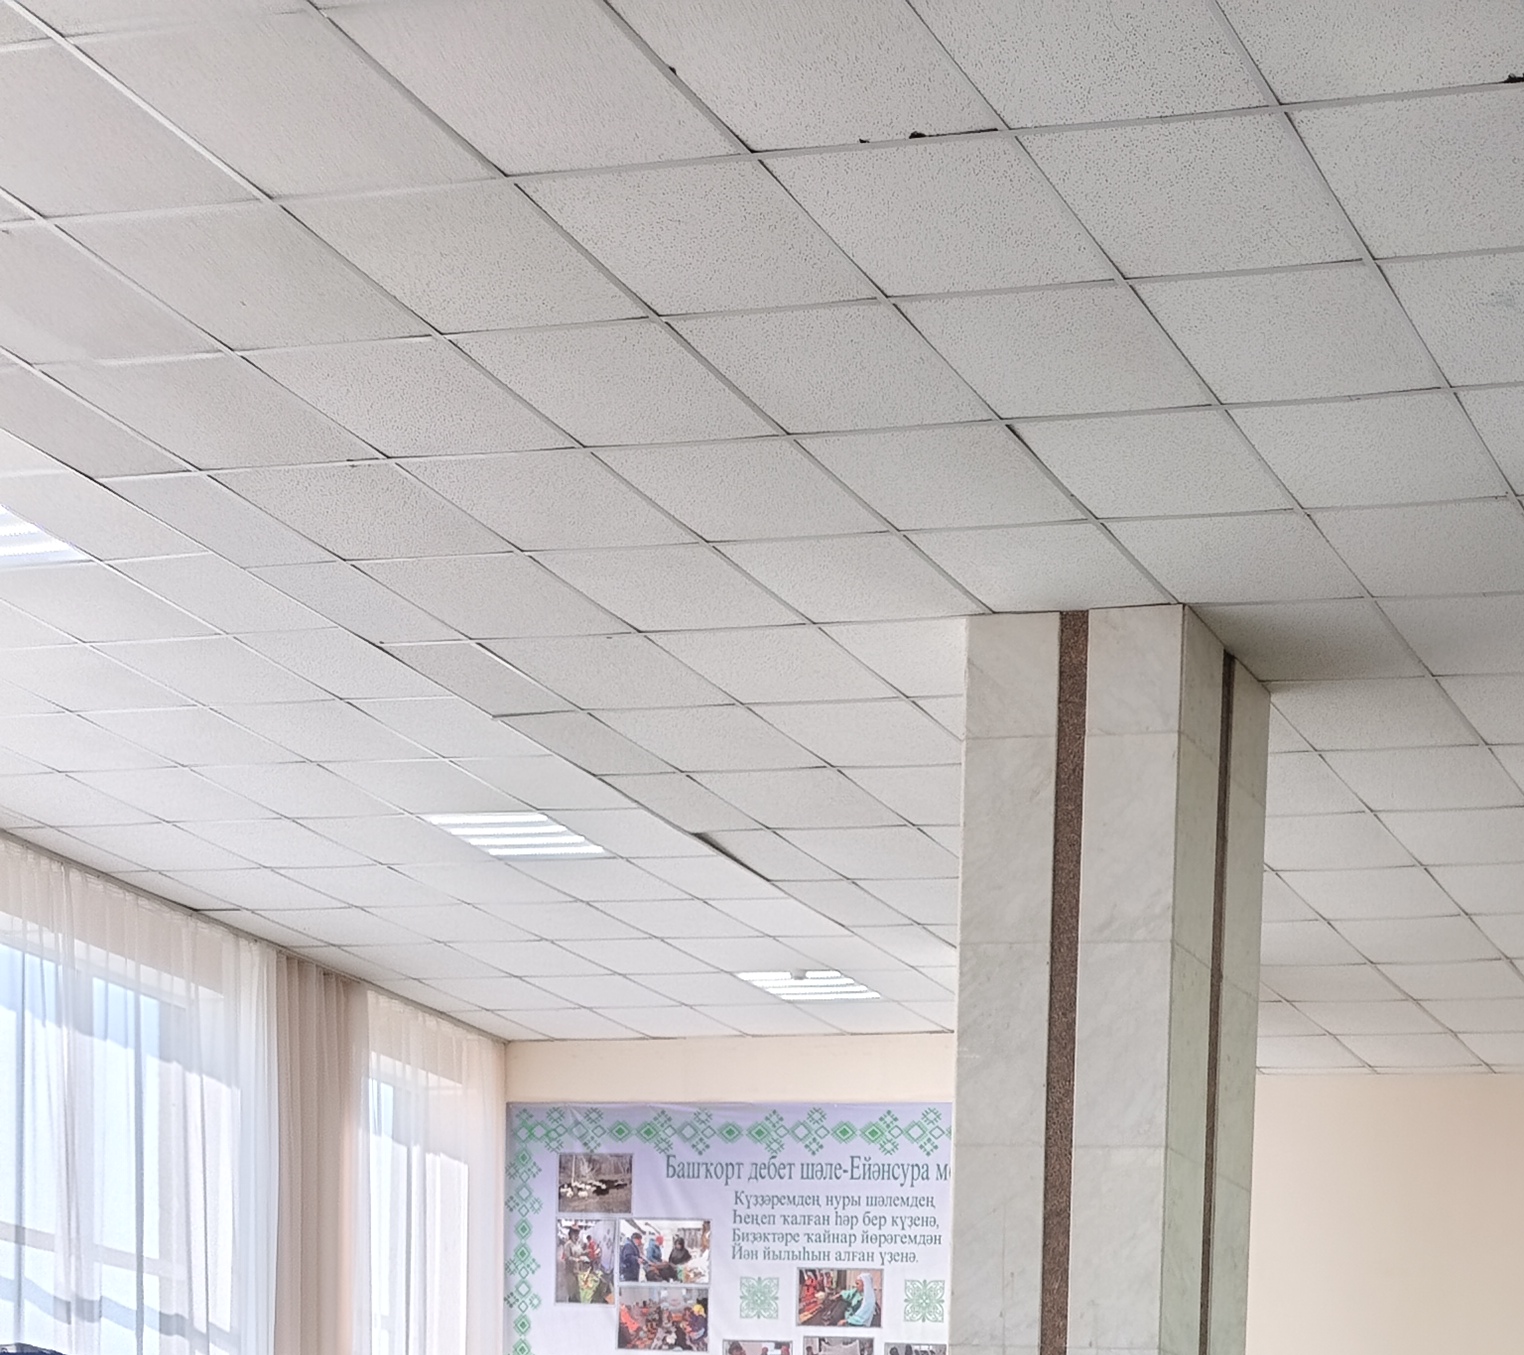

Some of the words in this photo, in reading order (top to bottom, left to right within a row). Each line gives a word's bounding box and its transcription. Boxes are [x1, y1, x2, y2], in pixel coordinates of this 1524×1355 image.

[666, 1154, 744, 1186] Башҡорт
[748, 1155, 796, 1181] дебет
[800, 1155, 930, 1187] шәле-Ейәнсура
[826, 1195, 861, 1210] нуры
[865, 1195, 936, 1209] шәлемдең
[780, 1213, 830, 1226] ҡалған
[835, 1210, 859, 1230] һәр
[862, 1211, 887, 1230] бер
[804, 1229, 858, 1247] ҡайнар
[860, 1229, 943, 1248] йөрәгемдән
[731, 1242, 759, 1260] Йән
[763, 1246, 831, 1262] йылыһын
[835, 1250, 875, 1262] алған
